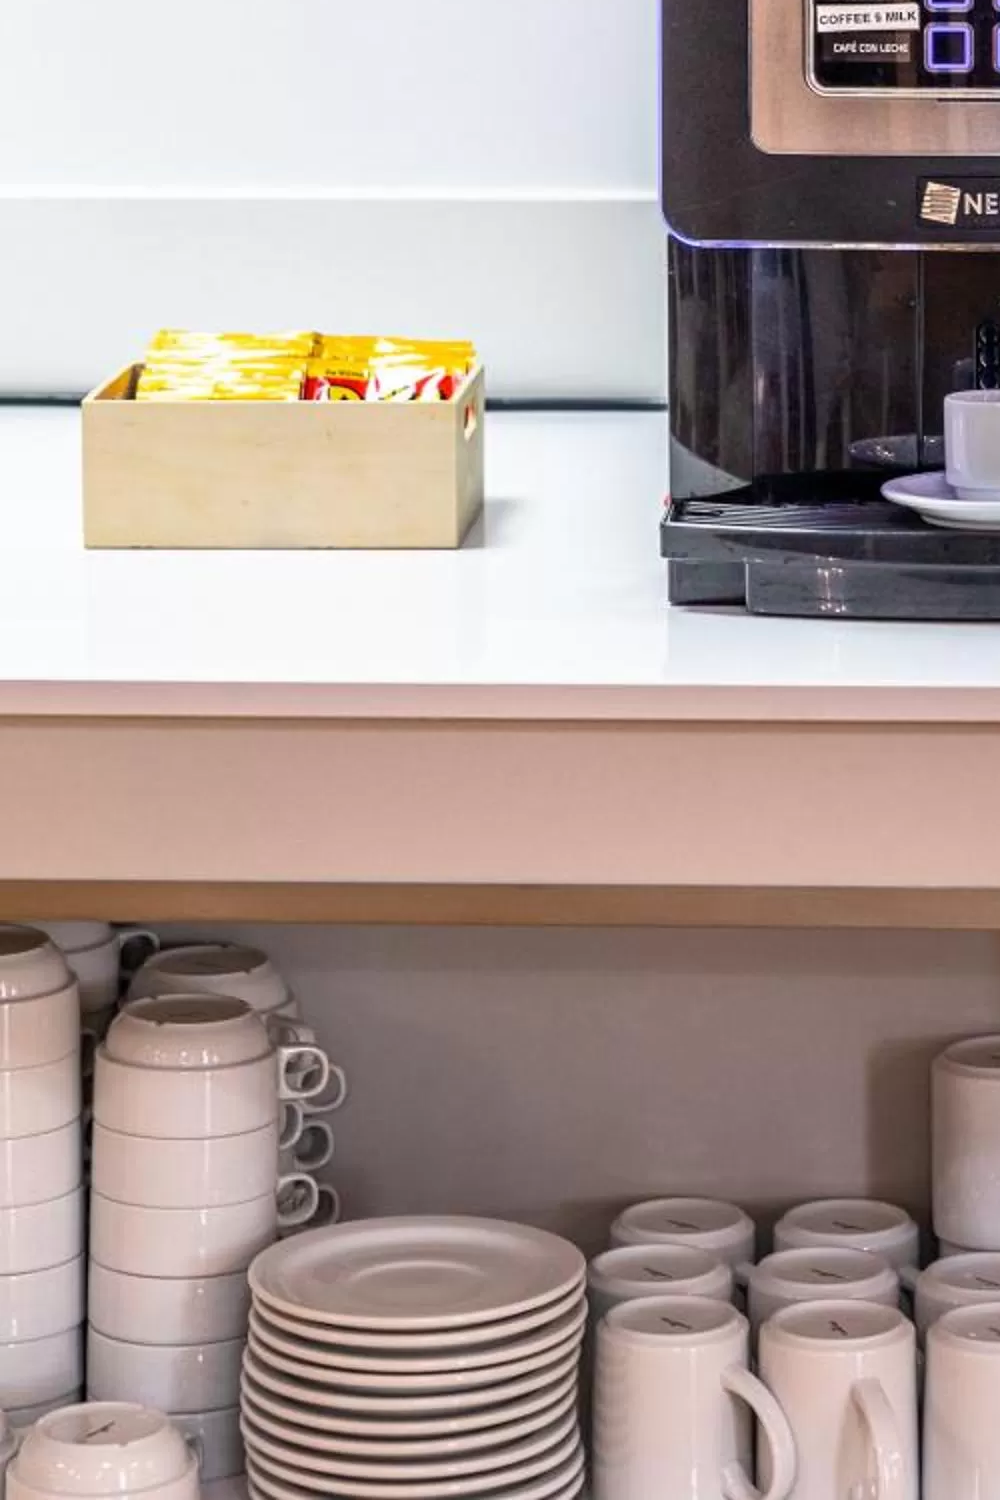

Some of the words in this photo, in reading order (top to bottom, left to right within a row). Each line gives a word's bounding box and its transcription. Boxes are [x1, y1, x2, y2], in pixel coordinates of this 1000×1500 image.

[819, 13, 872, 25] COFFEE
[885, 11, 917, 22] MILK
[833, 40, 857, 53] CAFÉ
[859, 43, 878, 53] CON
[880, 43, 909, 53] LECHE
